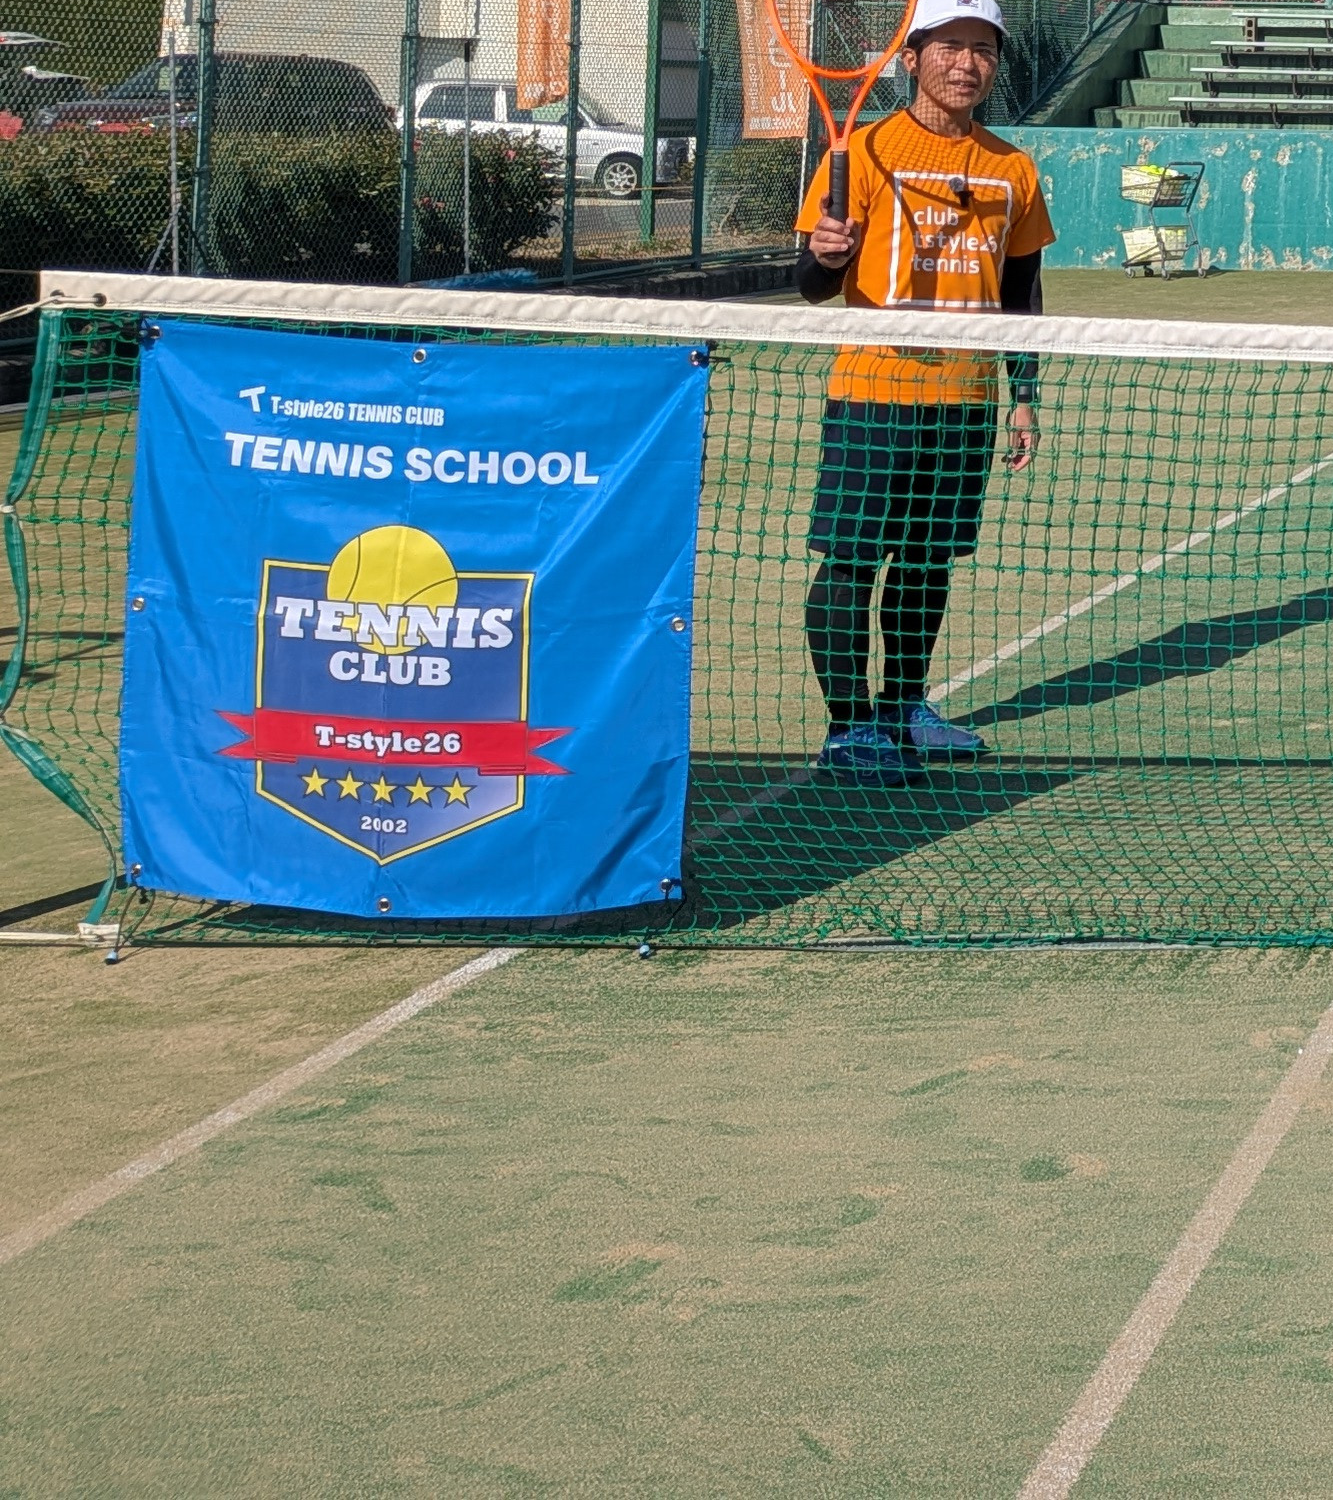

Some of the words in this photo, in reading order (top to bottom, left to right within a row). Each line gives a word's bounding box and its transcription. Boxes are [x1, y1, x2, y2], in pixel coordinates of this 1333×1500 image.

[913, 206, 959, 226] club
[914, 230, 998, 254] tstyle26
[912, 255, 980, 274] tennis
[271, 396, 345, 420] T-style26
[348, 403, 402, 424] TENNIS
[405, 406, 445, 427] CLUB
[225, 432, 393, 480] TENNIS
[404, 447, 599, 485] SCHOOL
[275, 596, 514, 649] TENNIS
[329, 650, 452, 686] CLUB
[315, 725, 462, 758] T-style26
[360, 815, 408, 834] 2002
